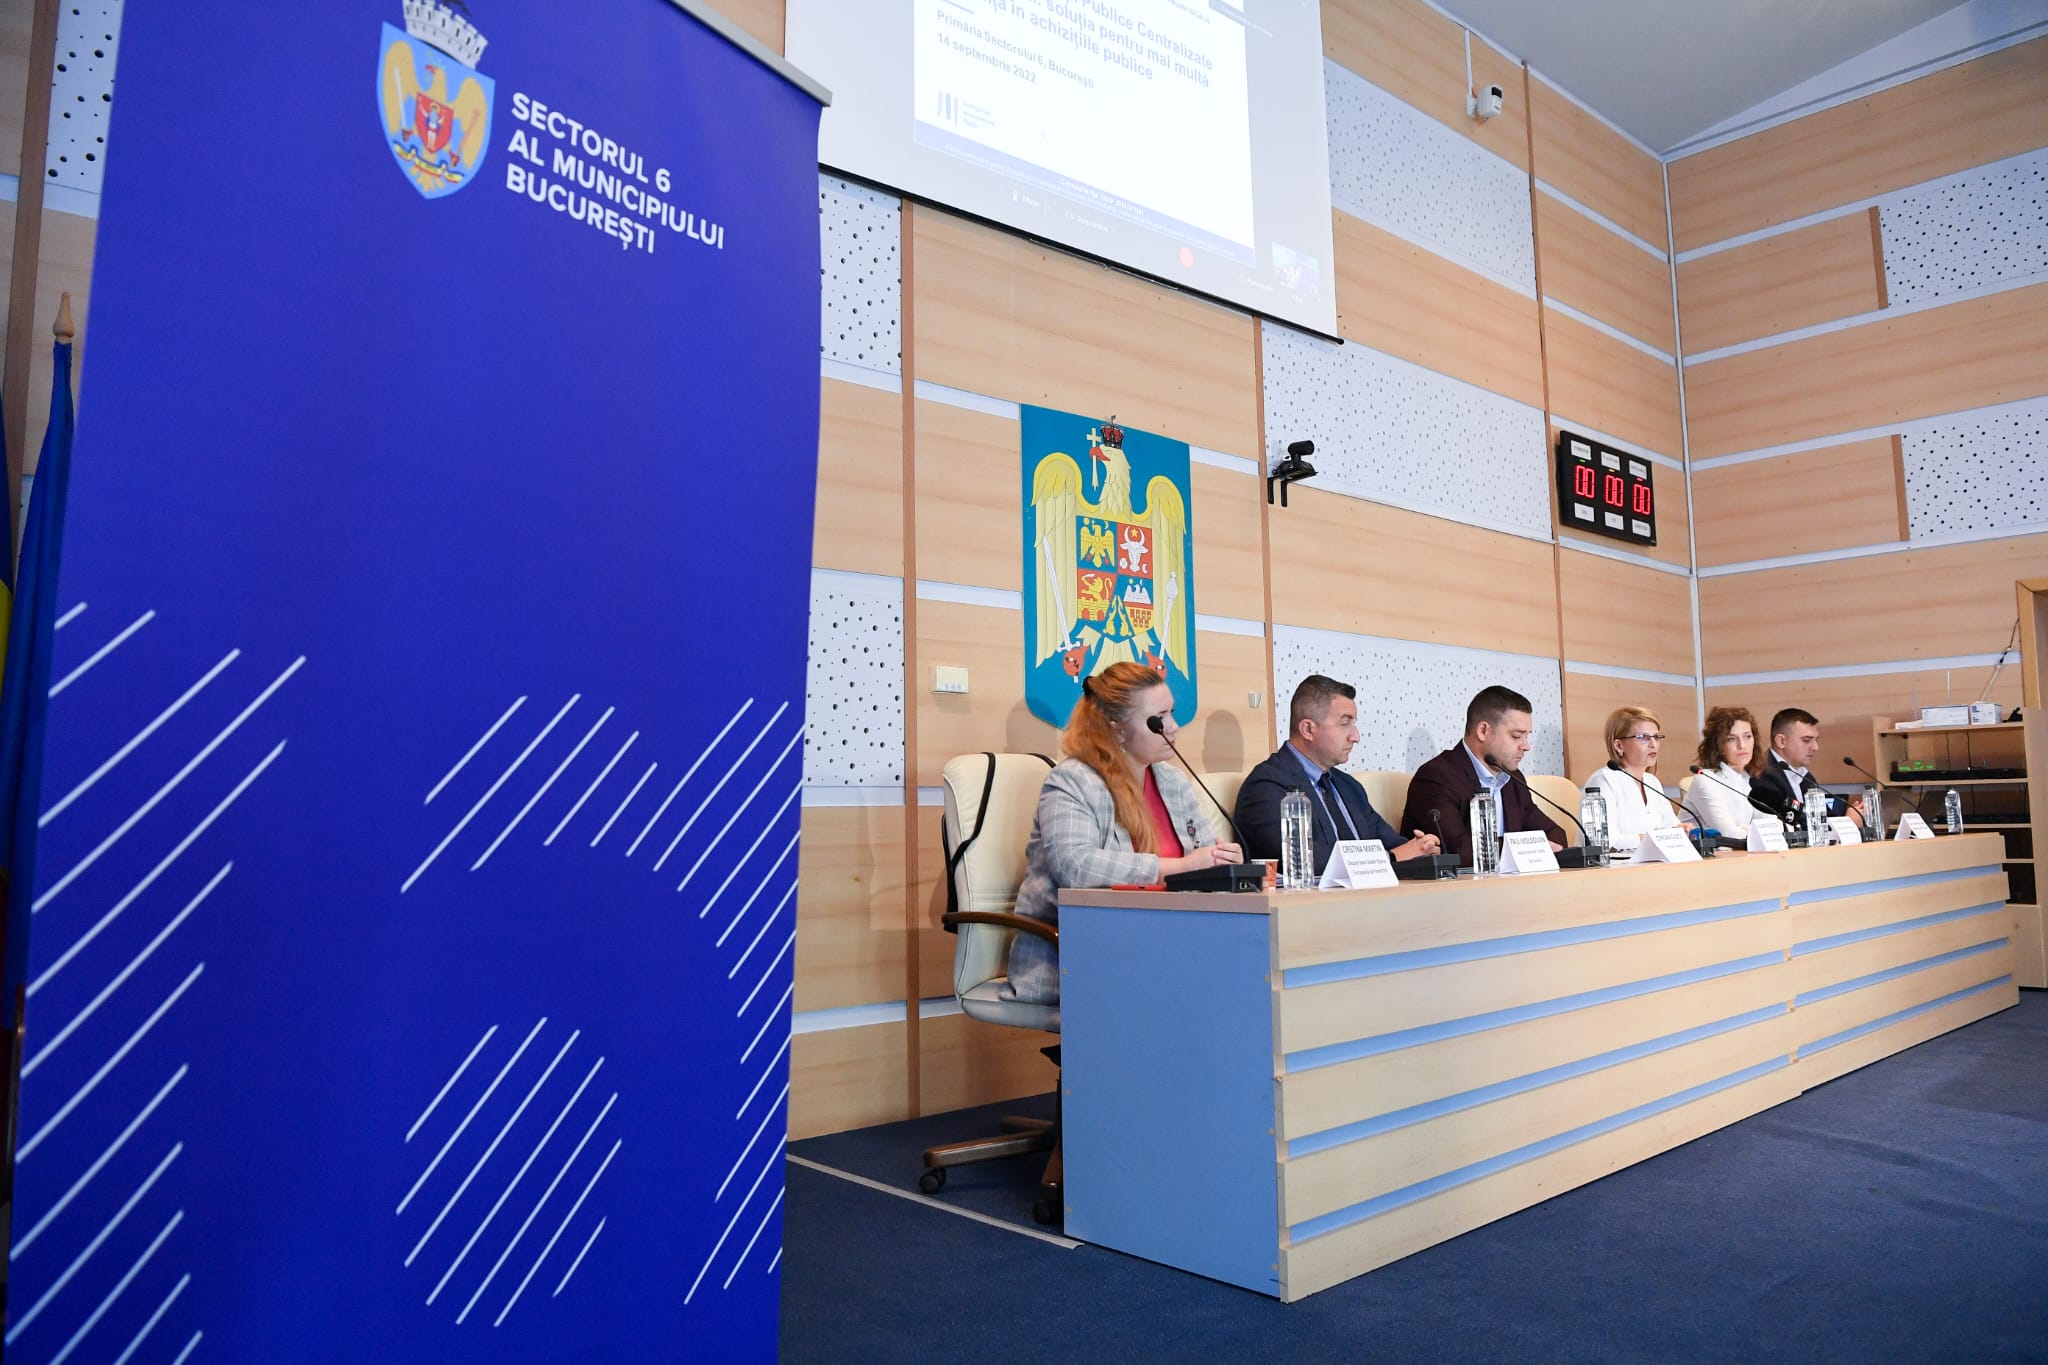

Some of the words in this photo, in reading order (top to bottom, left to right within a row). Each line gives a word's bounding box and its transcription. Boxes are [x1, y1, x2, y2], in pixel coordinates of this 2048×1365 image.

[937, 32, 950, 46] 14
[953, 40, 1011, 72] septembrie
[1013, 64, 1037, 84] 2022
[984, 31, 1036, 63] Sectorului
[1099, 25, 1143, 55] pentru
[1147, 48, 1171, 69] mai
[1175, 61, 1209, 88] multă
[1103, 47, 1153, 80] publice
[1136, 21, 1214, 71] Centralizate
[511, 92, 649, 184] SECTORUL
[655, 167, 671, 193] 6
[506, 163, 656, 254] BUCUREȘTI
[507, 129, 545, 167] AL
[552, 148, 725, 250] MUNICIPIULUI
